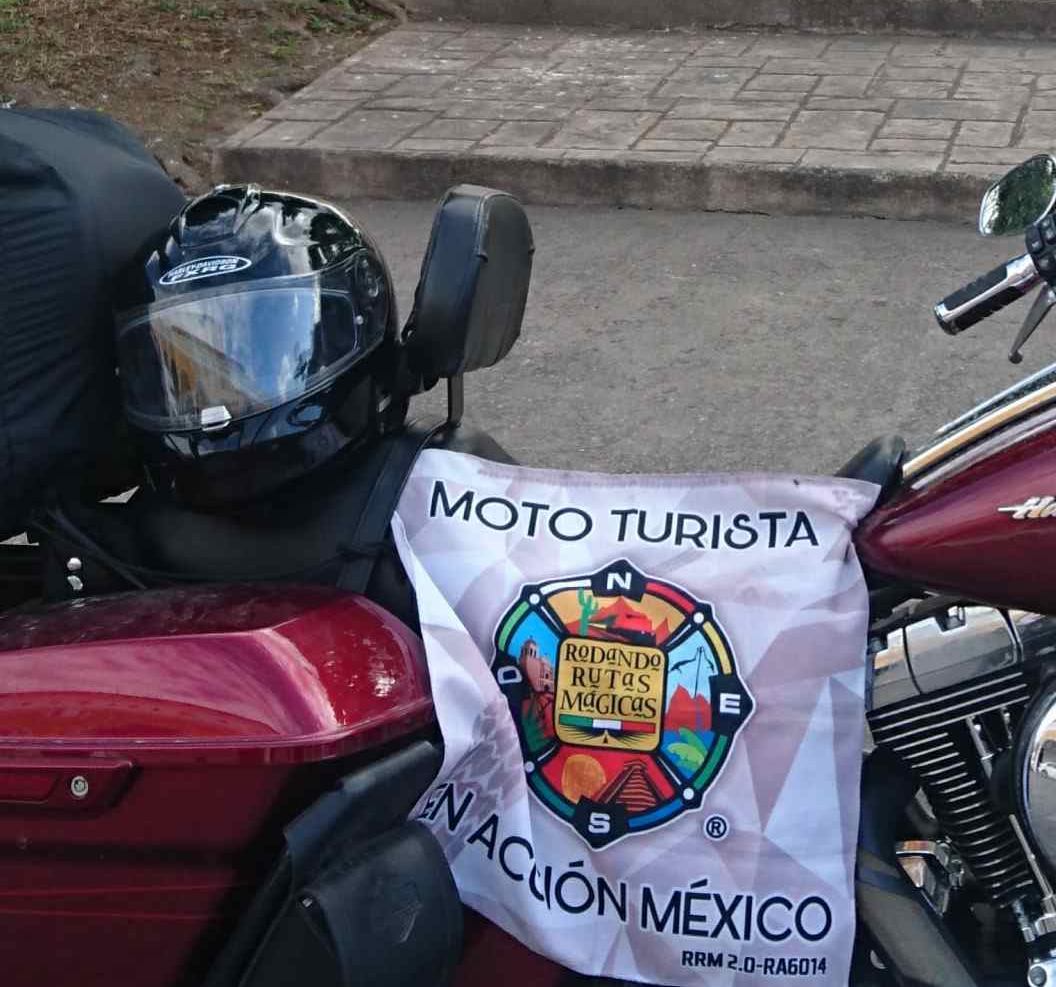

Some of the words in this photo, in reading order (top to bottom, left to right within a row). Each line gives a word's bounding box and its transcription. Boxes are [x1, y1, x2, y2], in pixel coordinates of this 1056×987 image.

[429, 480, 593, 541] MOTO
[610, 509, 819, 550] TURISTA
[606, 571, 632, 591] N
[720, 693, 741, 714] E
[588, 812, 611, 834] S
[641, 878, 832, 942] MÉXICO
[682, 950, 723, 968] RRM
